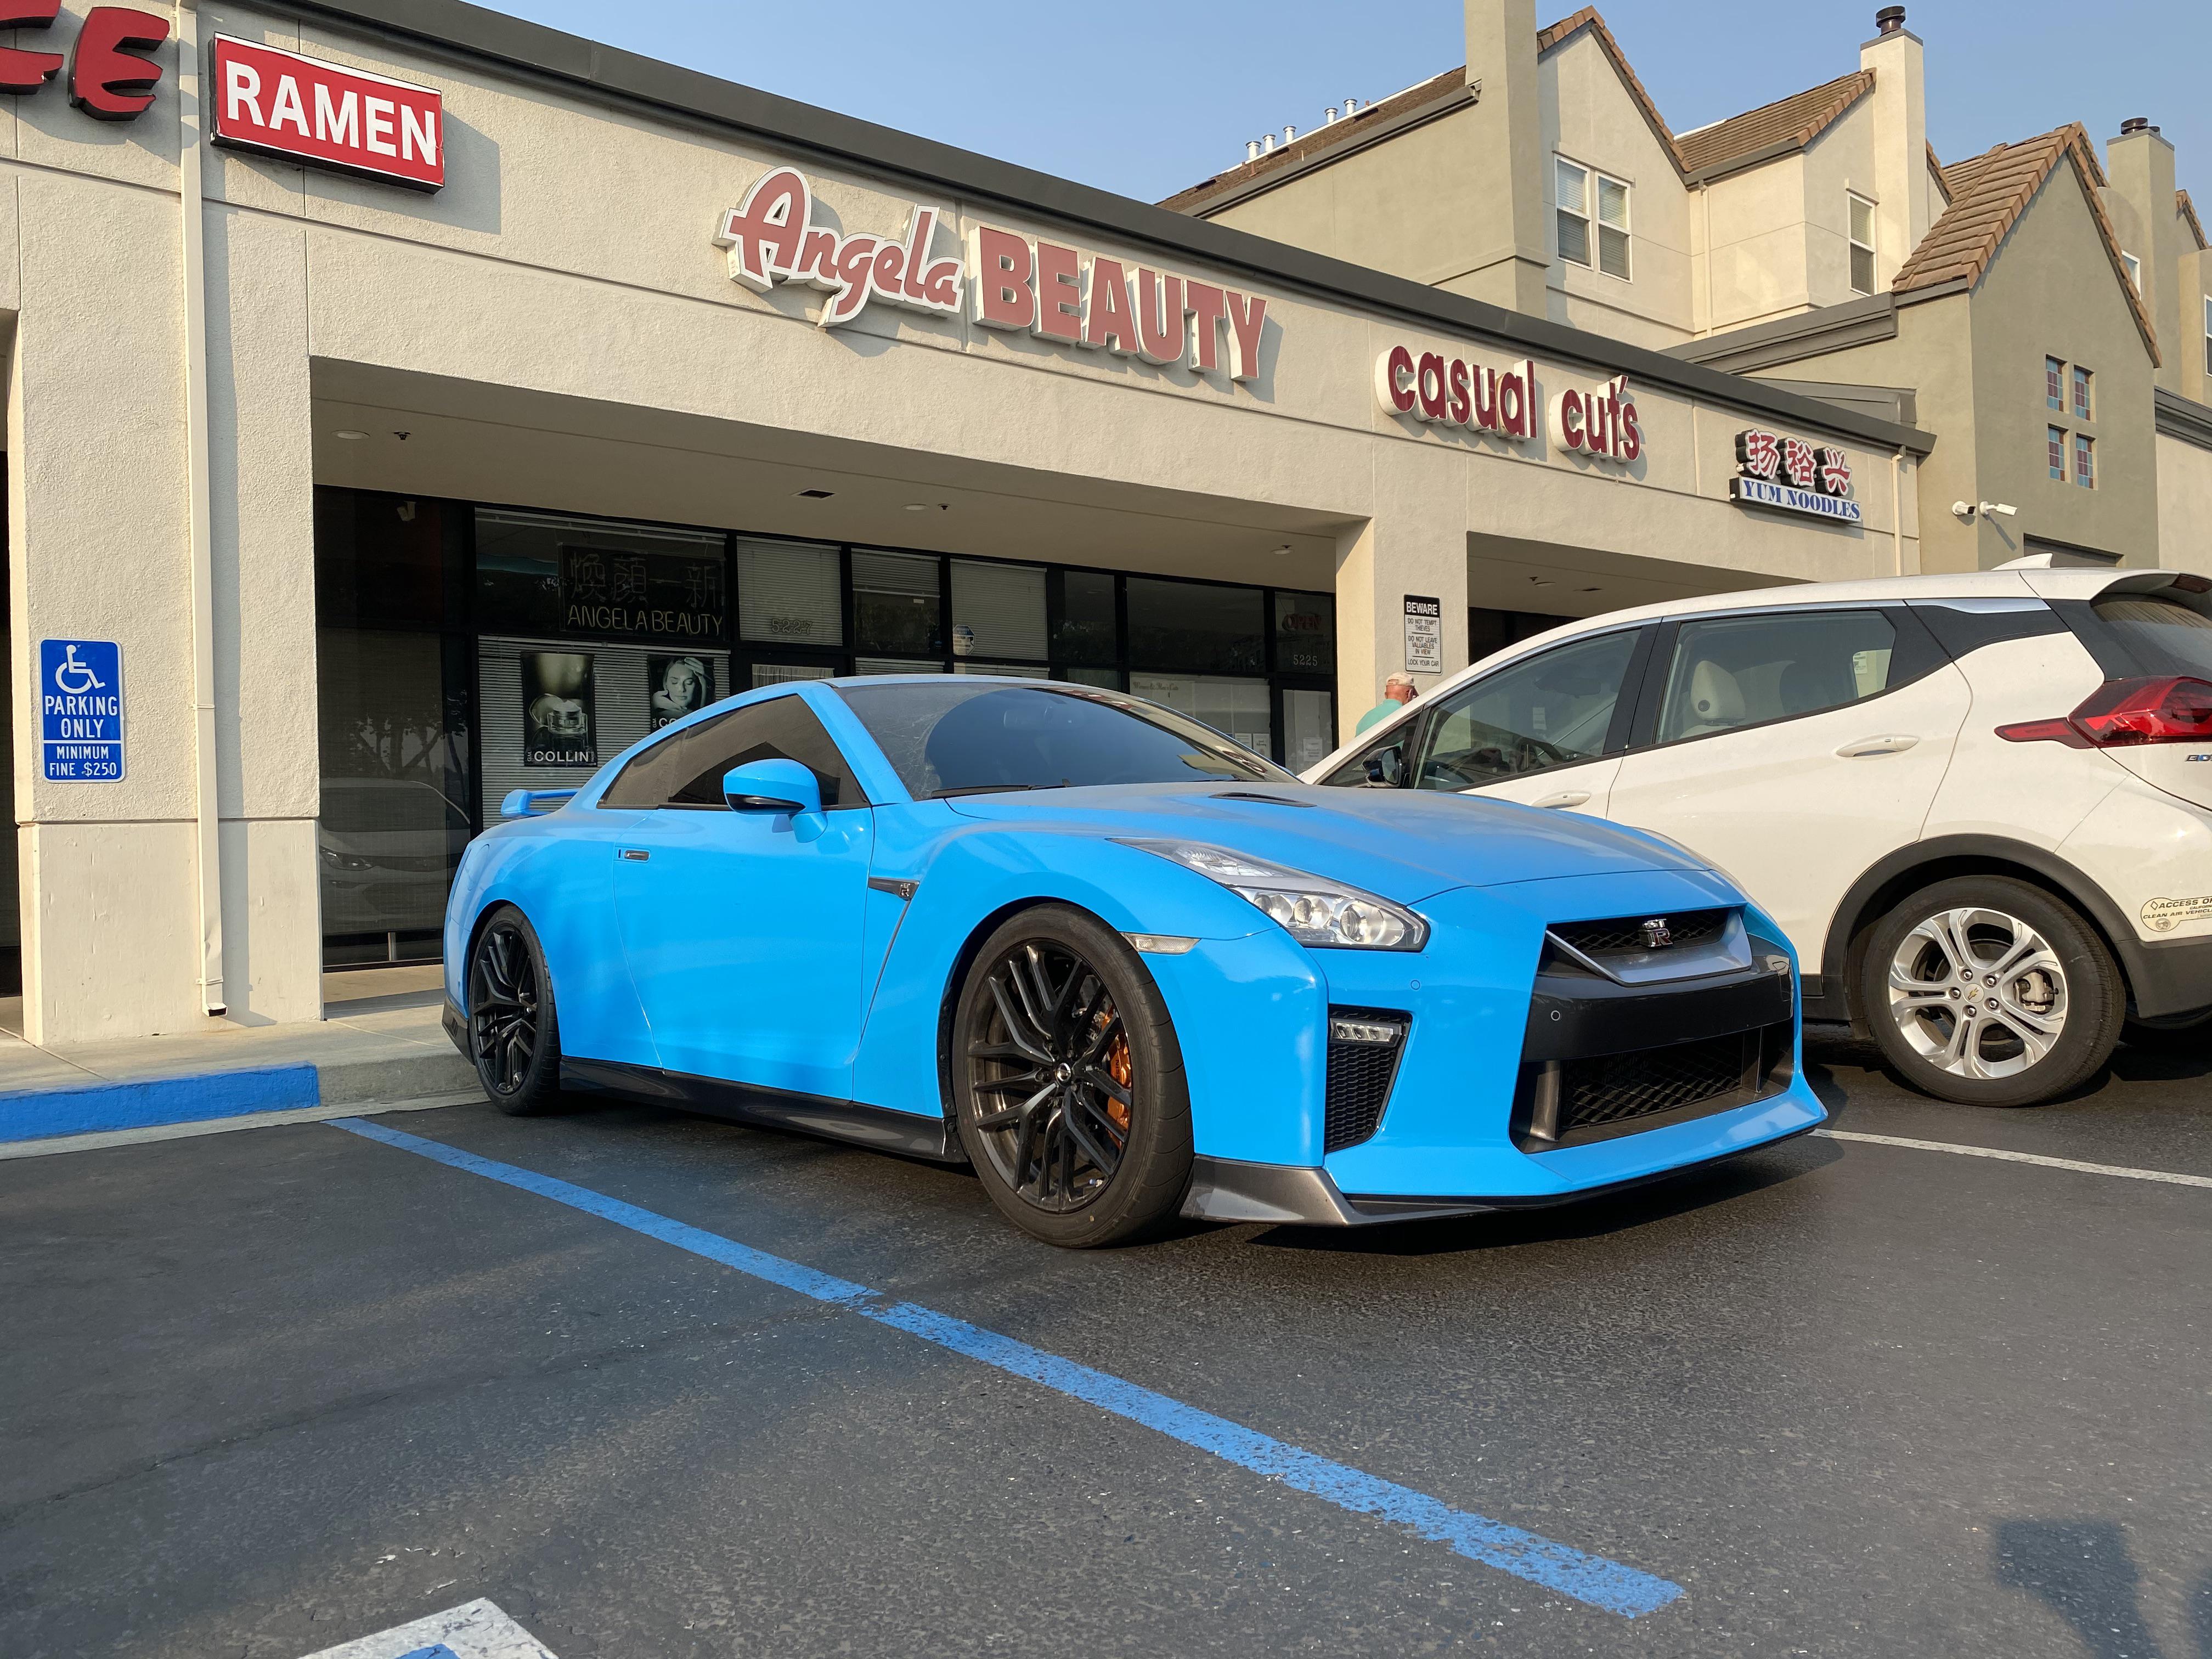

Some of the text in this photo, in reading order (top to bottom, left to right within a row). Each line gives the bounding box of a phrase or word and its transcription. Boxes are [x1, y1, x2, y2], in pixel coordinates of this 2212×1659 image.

[227, 59, 437, 166] RAMEN
[725, 166, 1267, 381] Angela BEAUTY
[1377, 345, 1537, 439] casual
[1745, 428, 1852, 496] 扬裕兴
[1743, 480, 1860, 519] YUM NOODLES
[1406, 601, 1438, 616] BEWARE
[567, 605, 723, 636] ANGELA BEAUTY
[772, 618, 812, 635] 5227
[1293, 654, 1318, 666] 5225
[44, 696, 118, 716] PARKING
[61, 718, 104, 738] ONLY
[57, 746, 109, 760] MINIMUM
[534, 751, 589, 762] COLLIN
[49, 761, 117, 777] FINE $250
[2158, 899, 2198, 909] ACCESS
